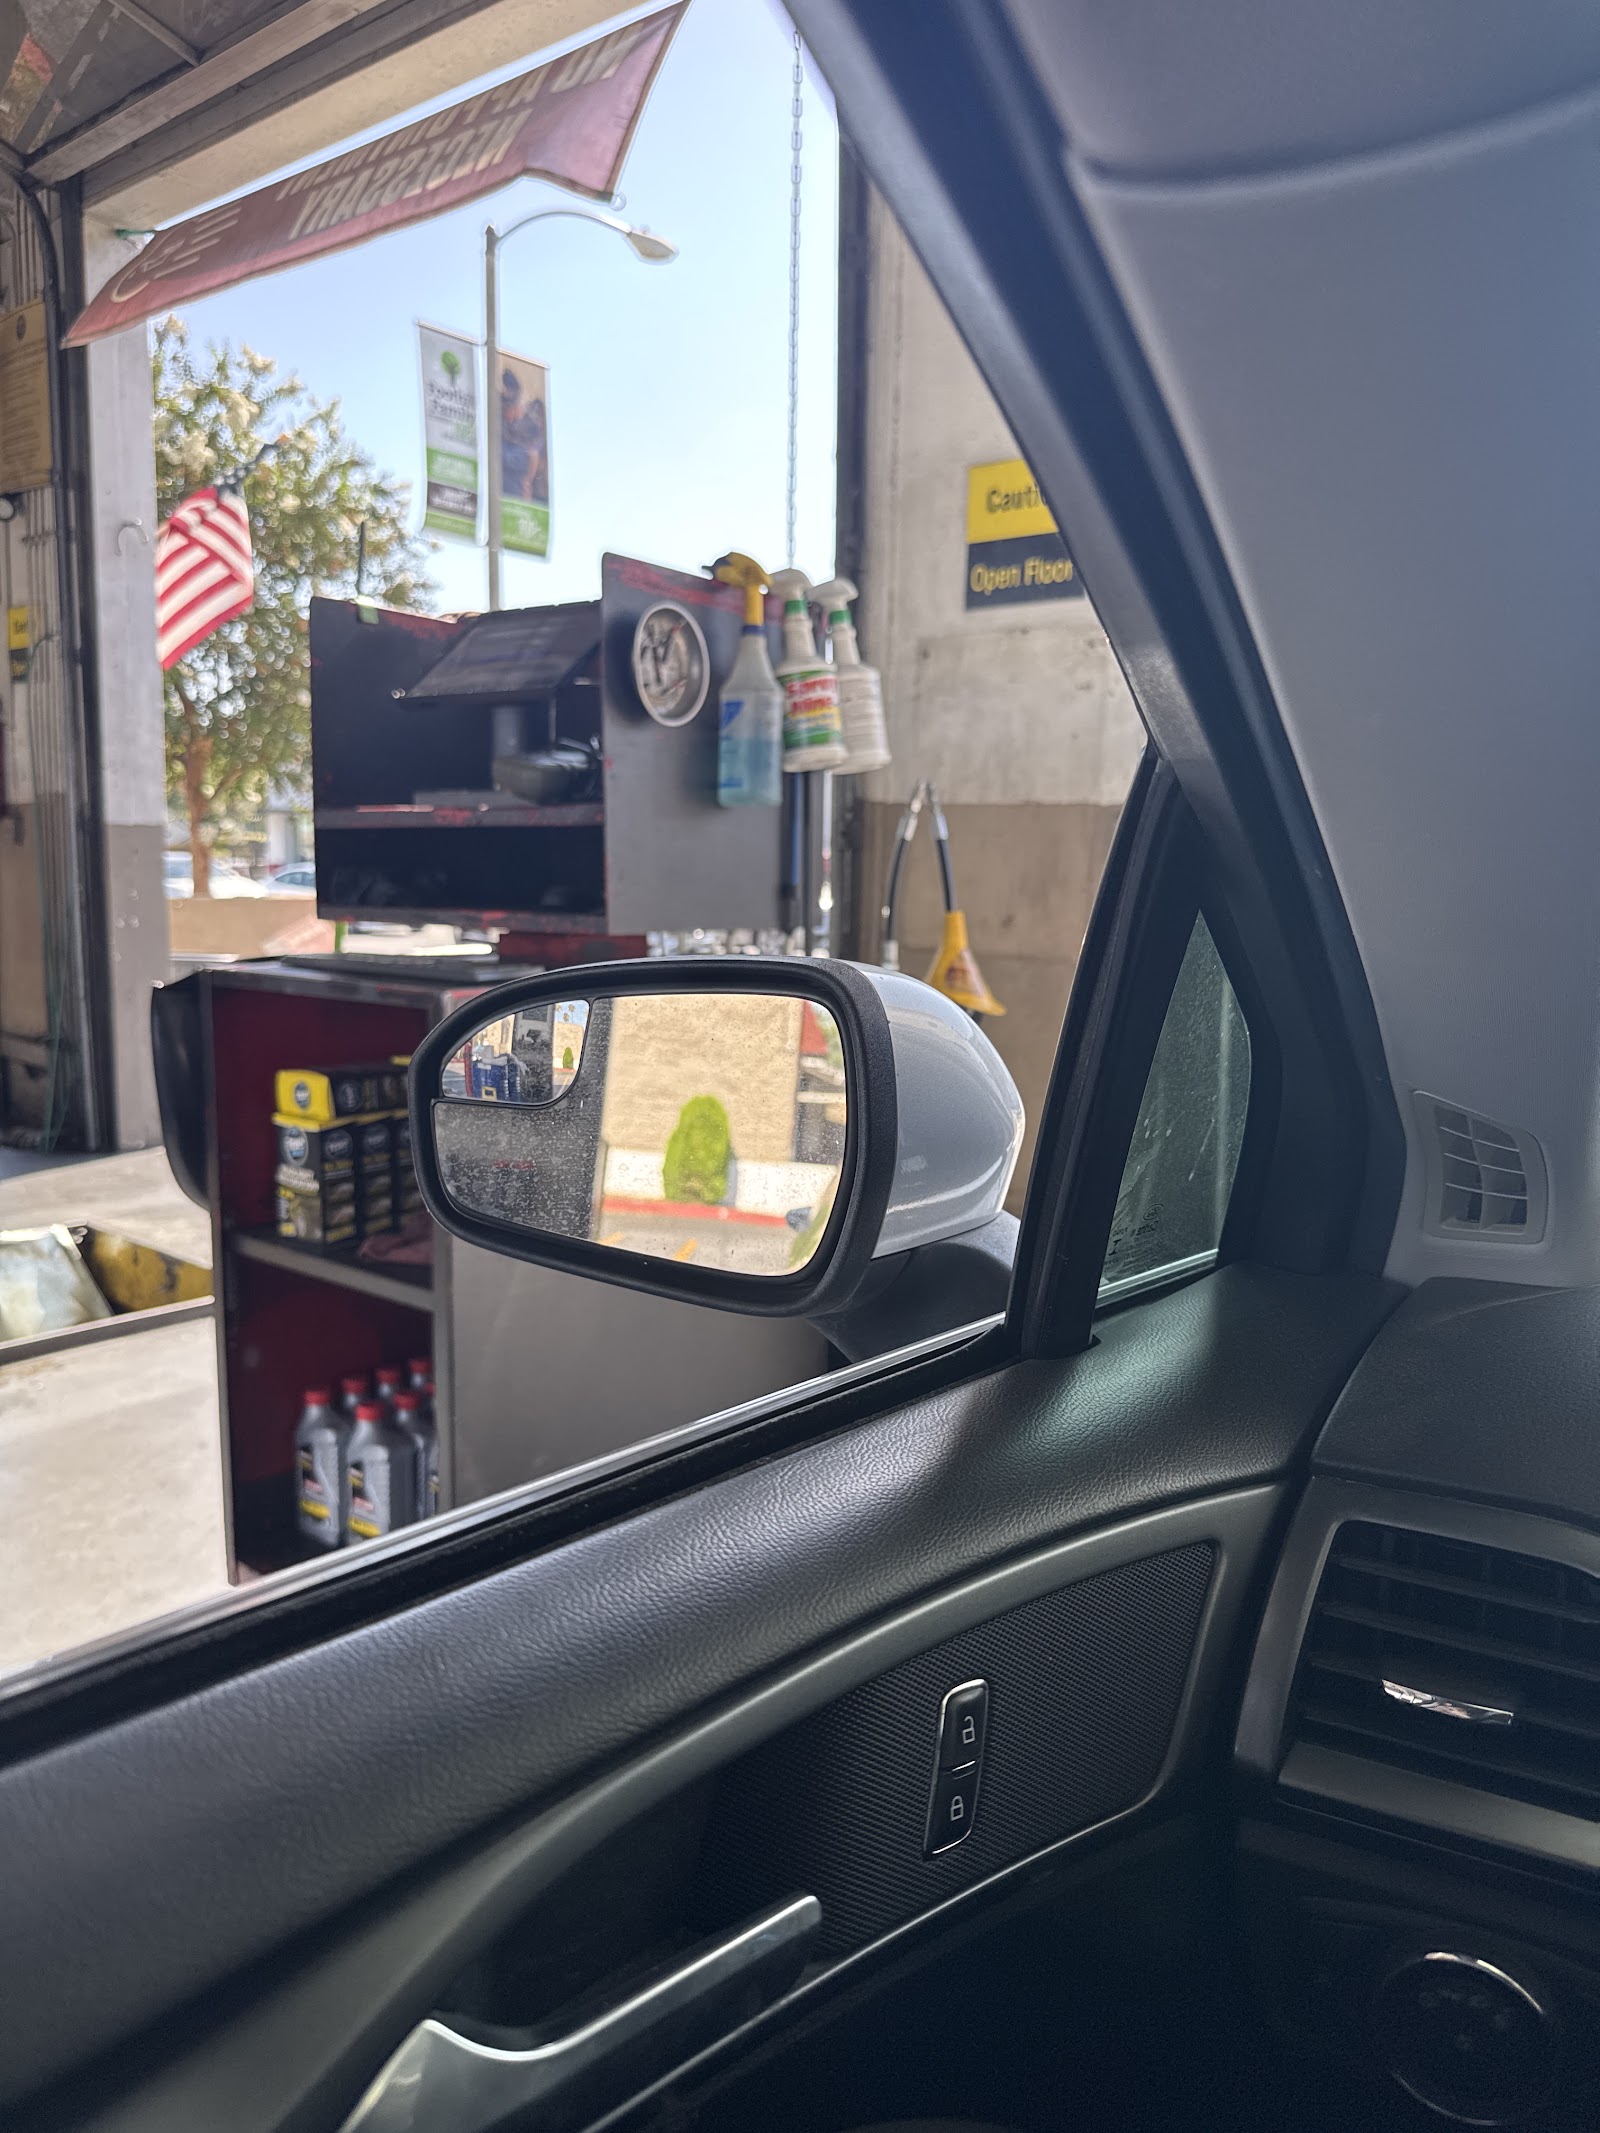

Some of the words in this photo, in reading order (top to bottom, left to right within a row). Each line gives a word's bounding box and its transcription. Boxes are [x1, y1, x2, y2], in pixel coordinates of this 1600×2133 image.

[986, 481, 1043, 514] Cauti
[970, 563, 1022, 596] Open
[1023, 556, 1074, 586] Floor
